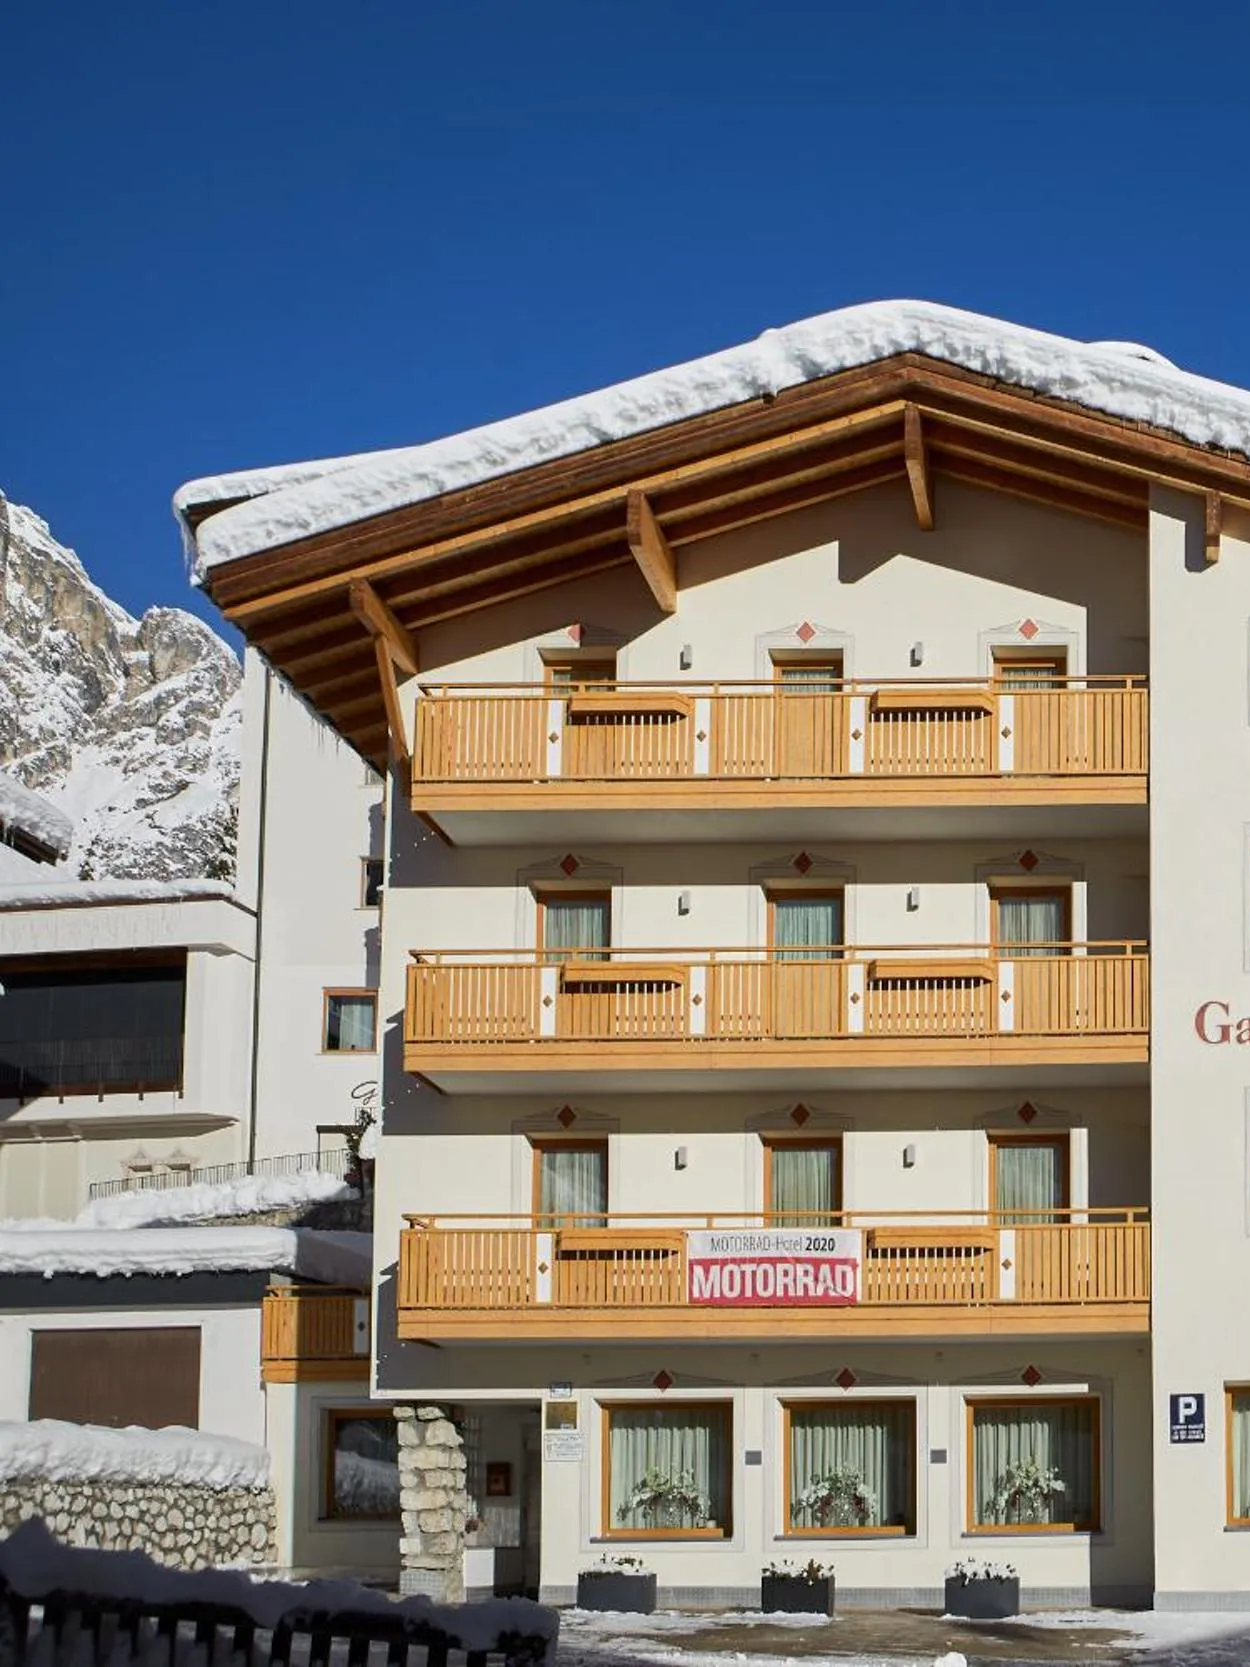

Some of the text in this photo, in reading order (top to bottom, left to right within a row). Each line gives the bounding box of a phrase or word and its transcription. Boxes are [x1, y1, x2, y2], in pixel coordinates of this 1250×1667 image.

[805, 1237, 836, 1252] 2020
[692, 1263, 855, 1299] MOTORRAD
[1179, 1396, 1198, 1424] P
